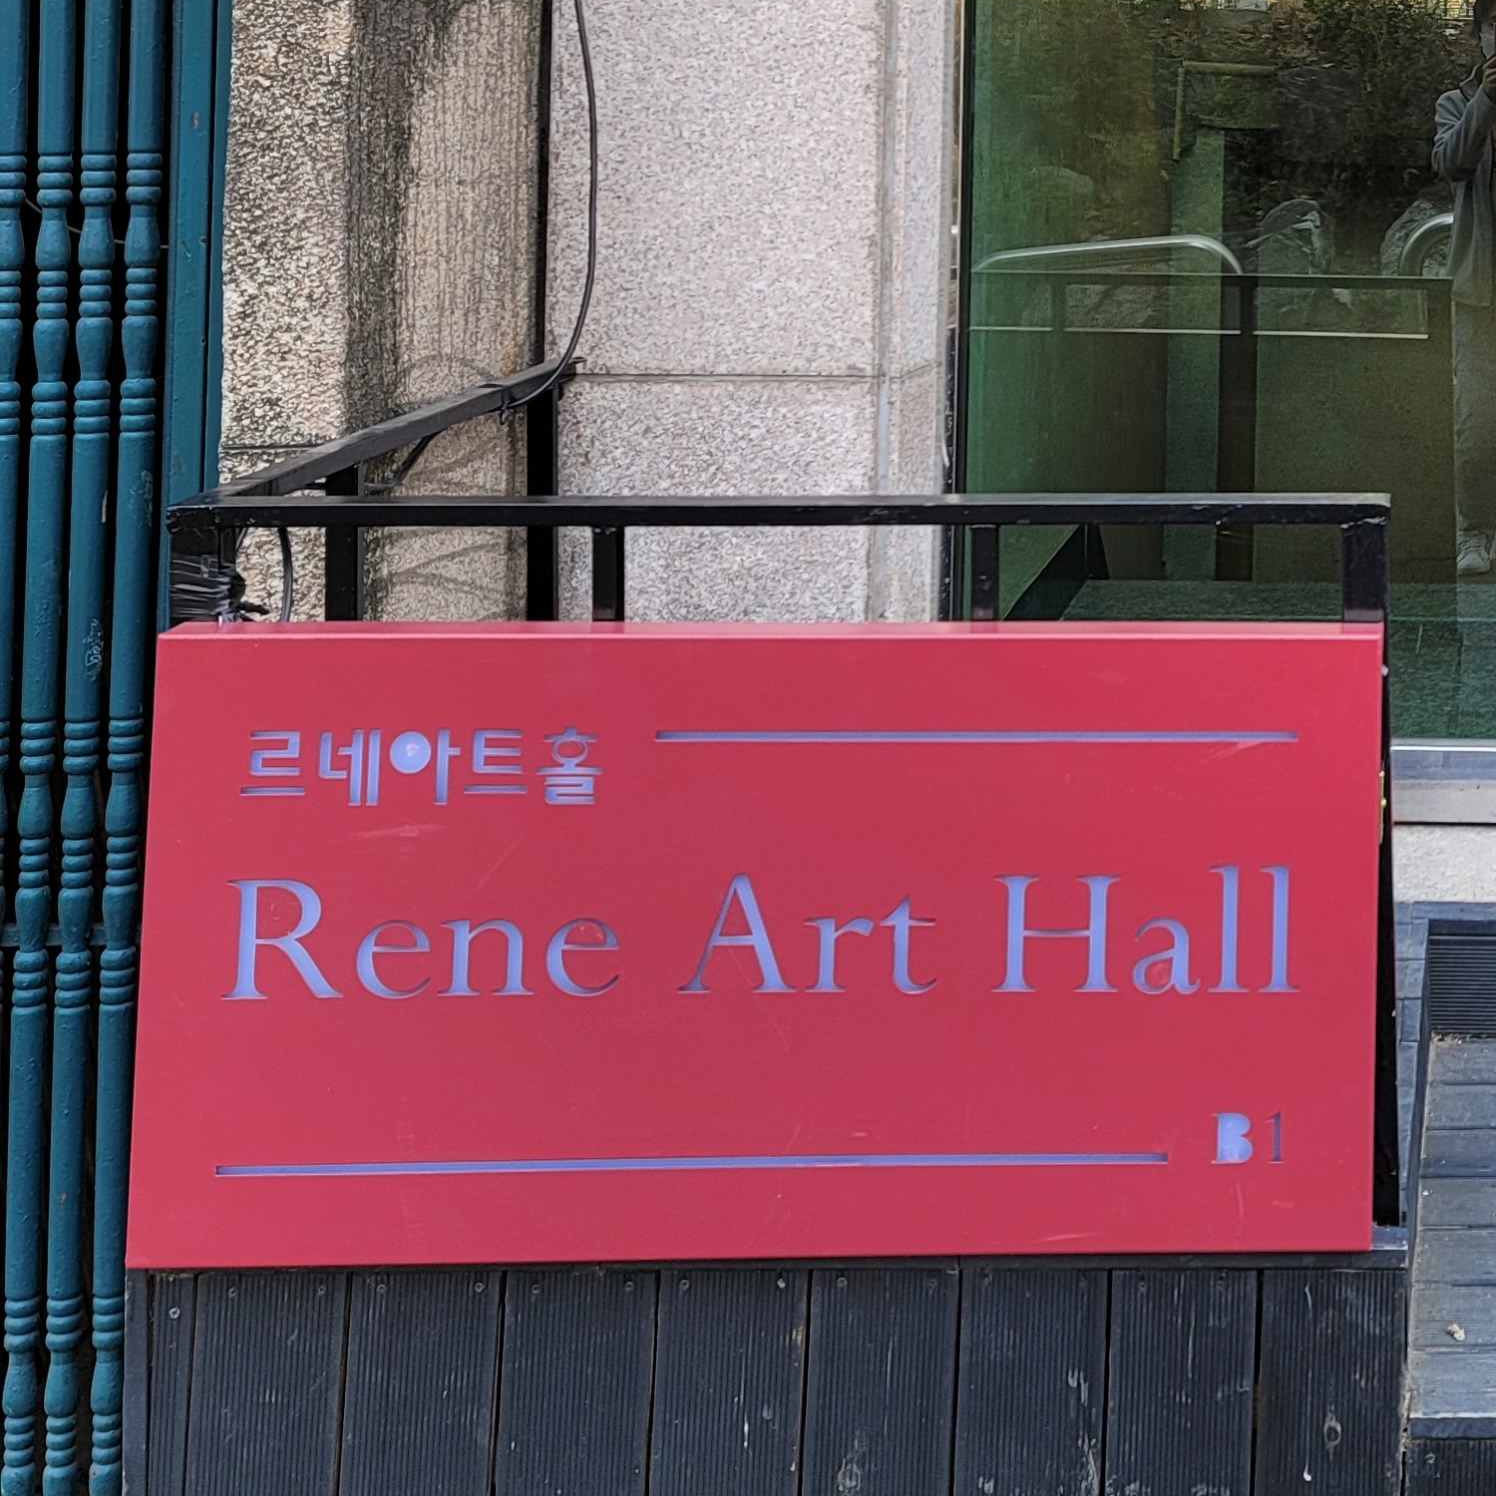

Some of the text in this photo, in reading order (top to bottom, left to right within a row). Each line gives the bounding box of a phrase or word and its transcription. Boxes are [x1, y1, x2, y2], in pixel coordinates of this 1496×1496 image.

[241, 726, 600, 807] 르네아트홀
[222, 865, 1301, 1000] Rene Art Hall
[1210, 1110, 1285, 1165] B1
